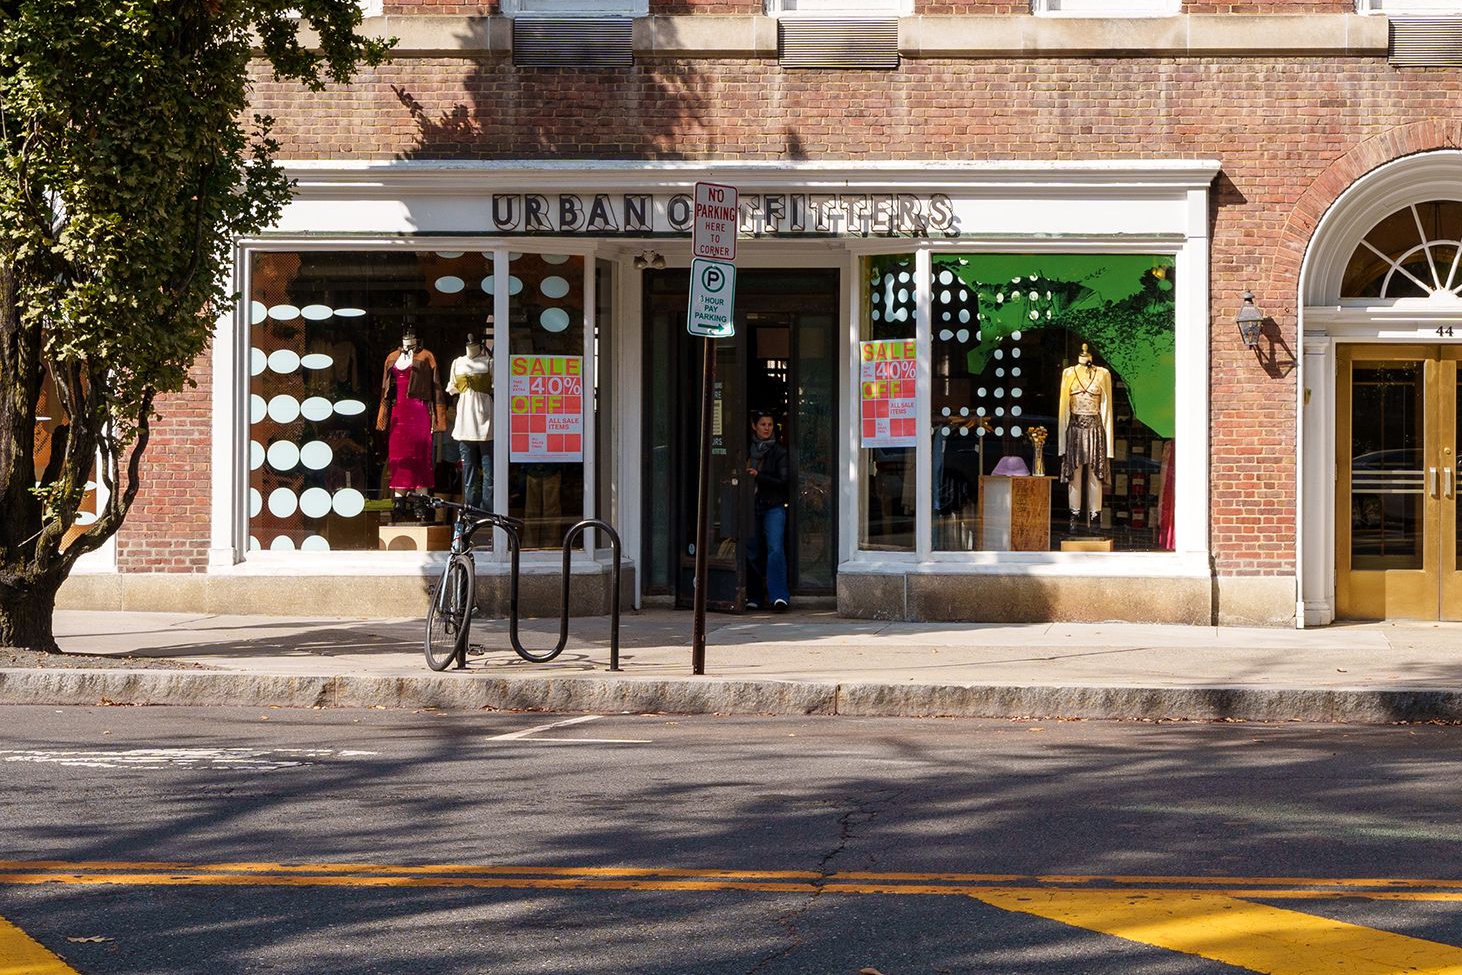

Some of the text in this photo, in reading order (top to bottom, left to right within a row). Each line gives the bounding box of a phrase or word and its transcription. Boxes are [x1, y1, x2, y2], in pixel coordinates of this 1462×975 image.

[708, 188, 725, 203] NO
[493, 193, 954, 232] URBAN OTFITTERS
[696, 204, 735, 222] PARKING
[705, 221, 726, 232] HERE
[711, 233, 720, 243] TO
[700, 244, 730, 256] CORNER
[707, 270, 720, 287] P
[704, 304, 718, 313] PAY
[705, 296, 724, 306] HOUR
[694, 311, 727, 323] PARKING
[1435, 325, 1454, 337] 44
[863, 341, 915, 362] SALE
[512, 356, 579, 376] SALE
[876, 360, 916, 379] 40%
[530, 377, 581, 395] 40%
[862, 381, 902, 399] OFF
[511, 396, 562, 414] OFF
